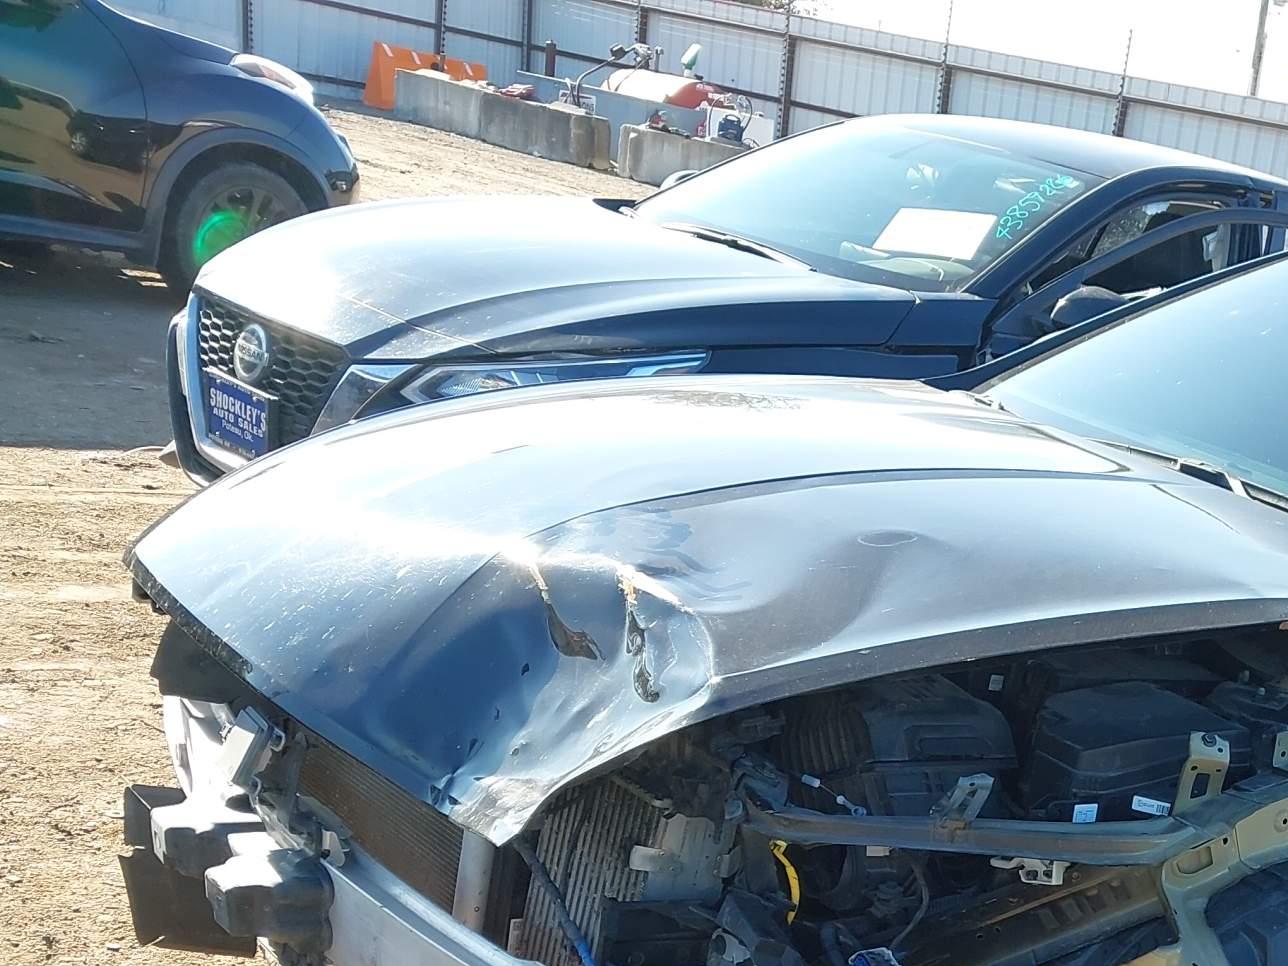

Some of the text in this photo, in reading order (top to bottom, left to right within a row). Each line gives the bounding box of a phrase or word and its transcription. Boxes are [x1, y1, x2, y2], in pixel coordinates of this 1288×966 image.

[210, 388, 266, 431] SHOCKLEY'S
[213, 407, 263, 438] AUTO SALES
